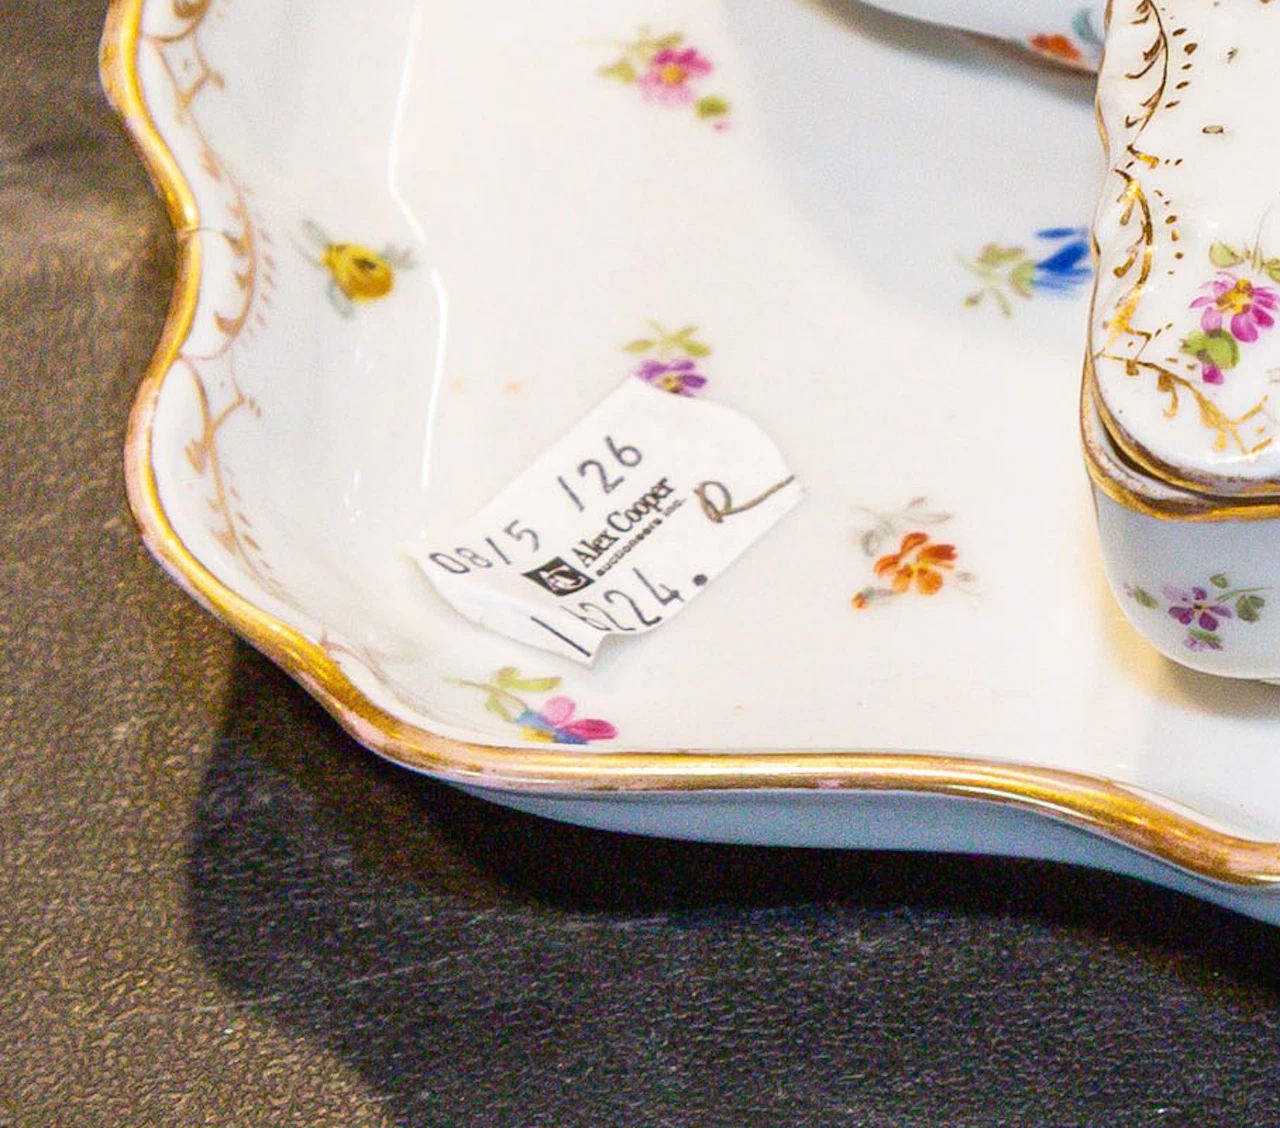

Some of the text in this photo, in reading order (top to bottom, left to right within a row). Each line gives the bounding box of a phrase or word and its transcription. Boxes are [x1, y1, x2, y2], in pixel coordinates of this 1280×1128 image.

[572, 533, 611, 568] Alex
[607, 477, 678, 533] Cooper
[595, 518, 663, 578] auctioneers
